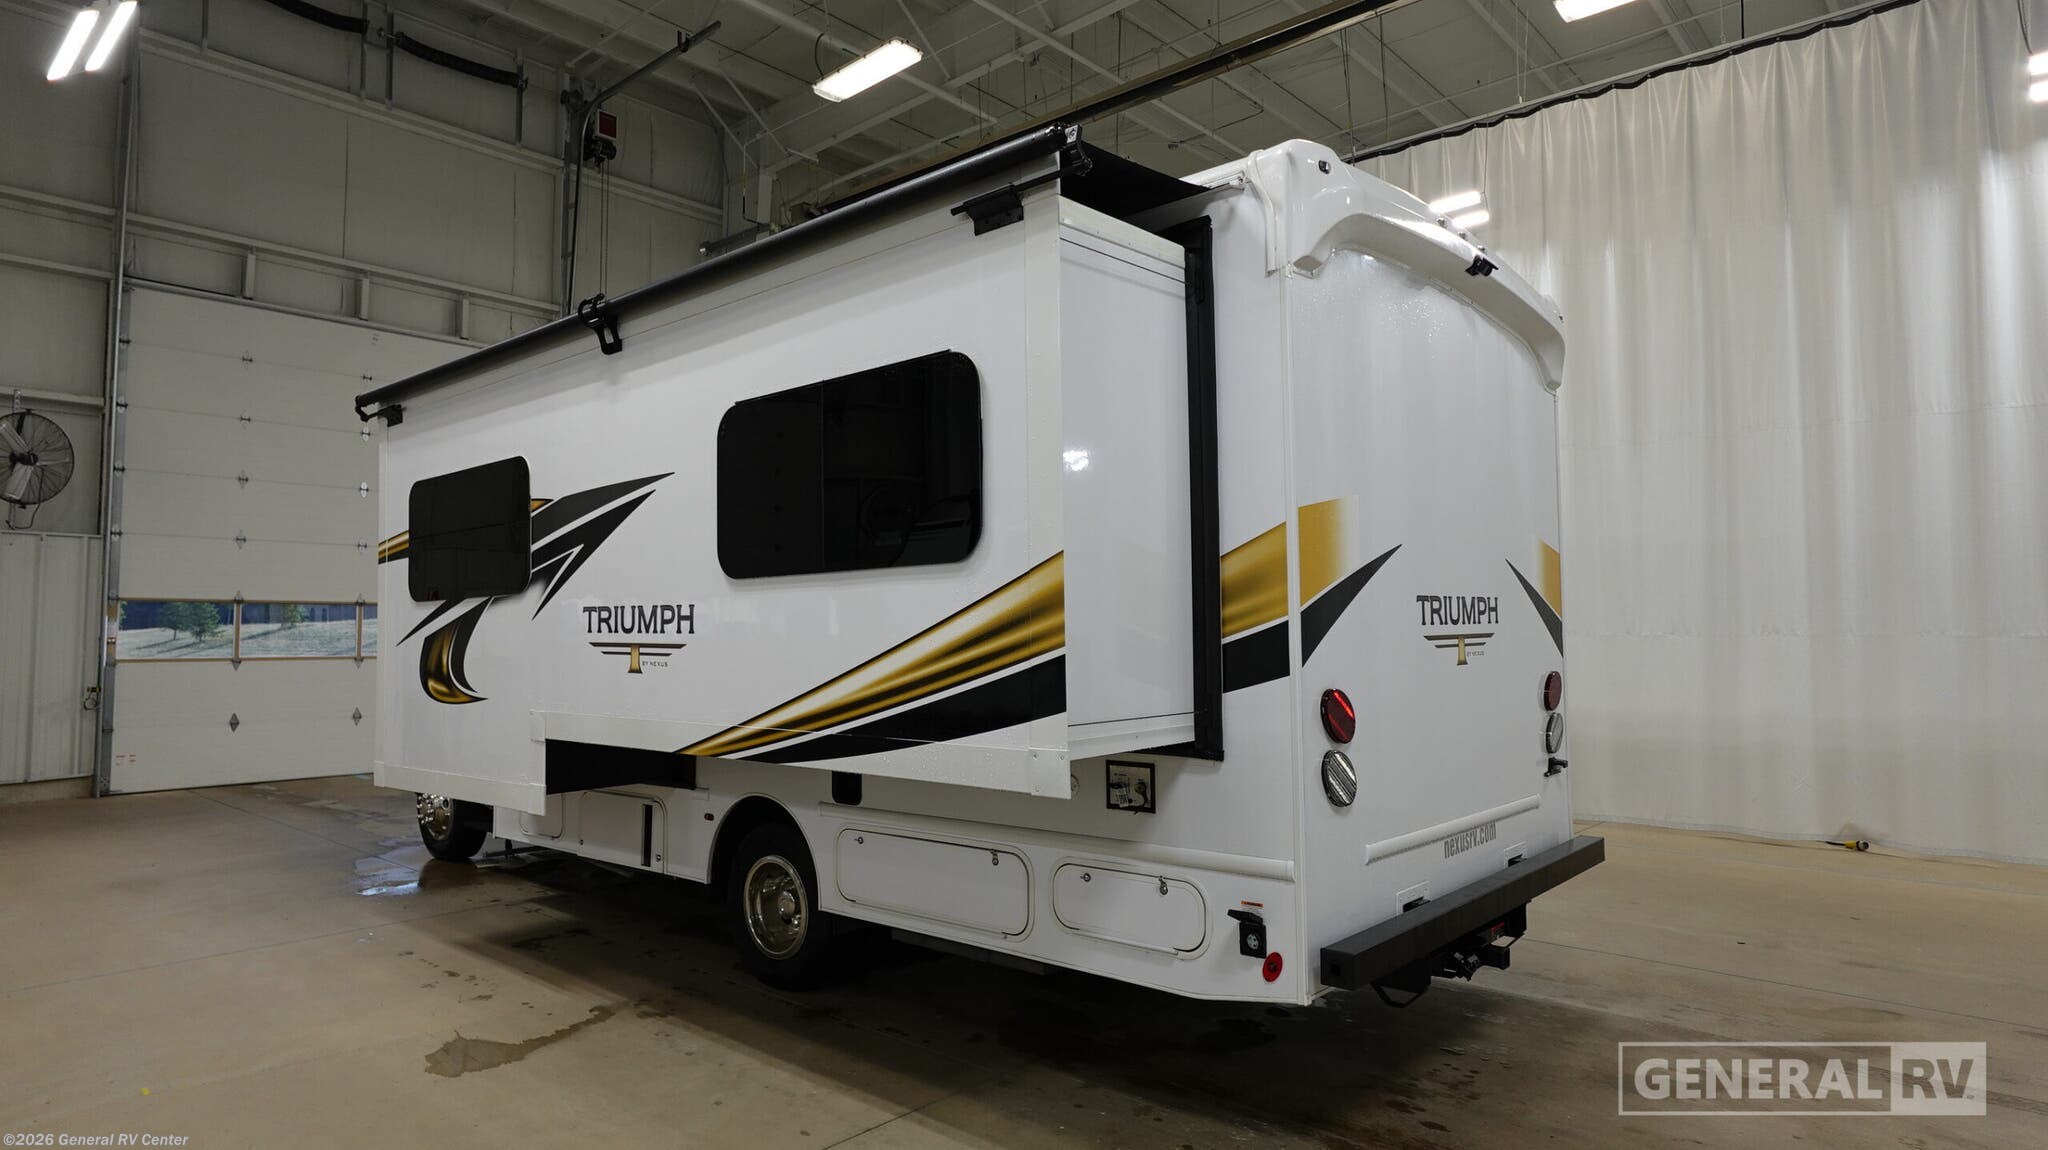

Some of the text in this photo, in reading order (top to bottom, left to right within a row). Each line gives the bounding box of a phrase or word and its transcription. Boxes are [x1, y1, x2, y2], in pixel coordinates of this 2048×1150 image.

[583, 604, 695, 634] TRIUMPH
[1416, 595, 1499, 626] TRIUMPH
[1444, 823, 1497, 859] nexusrv.com
